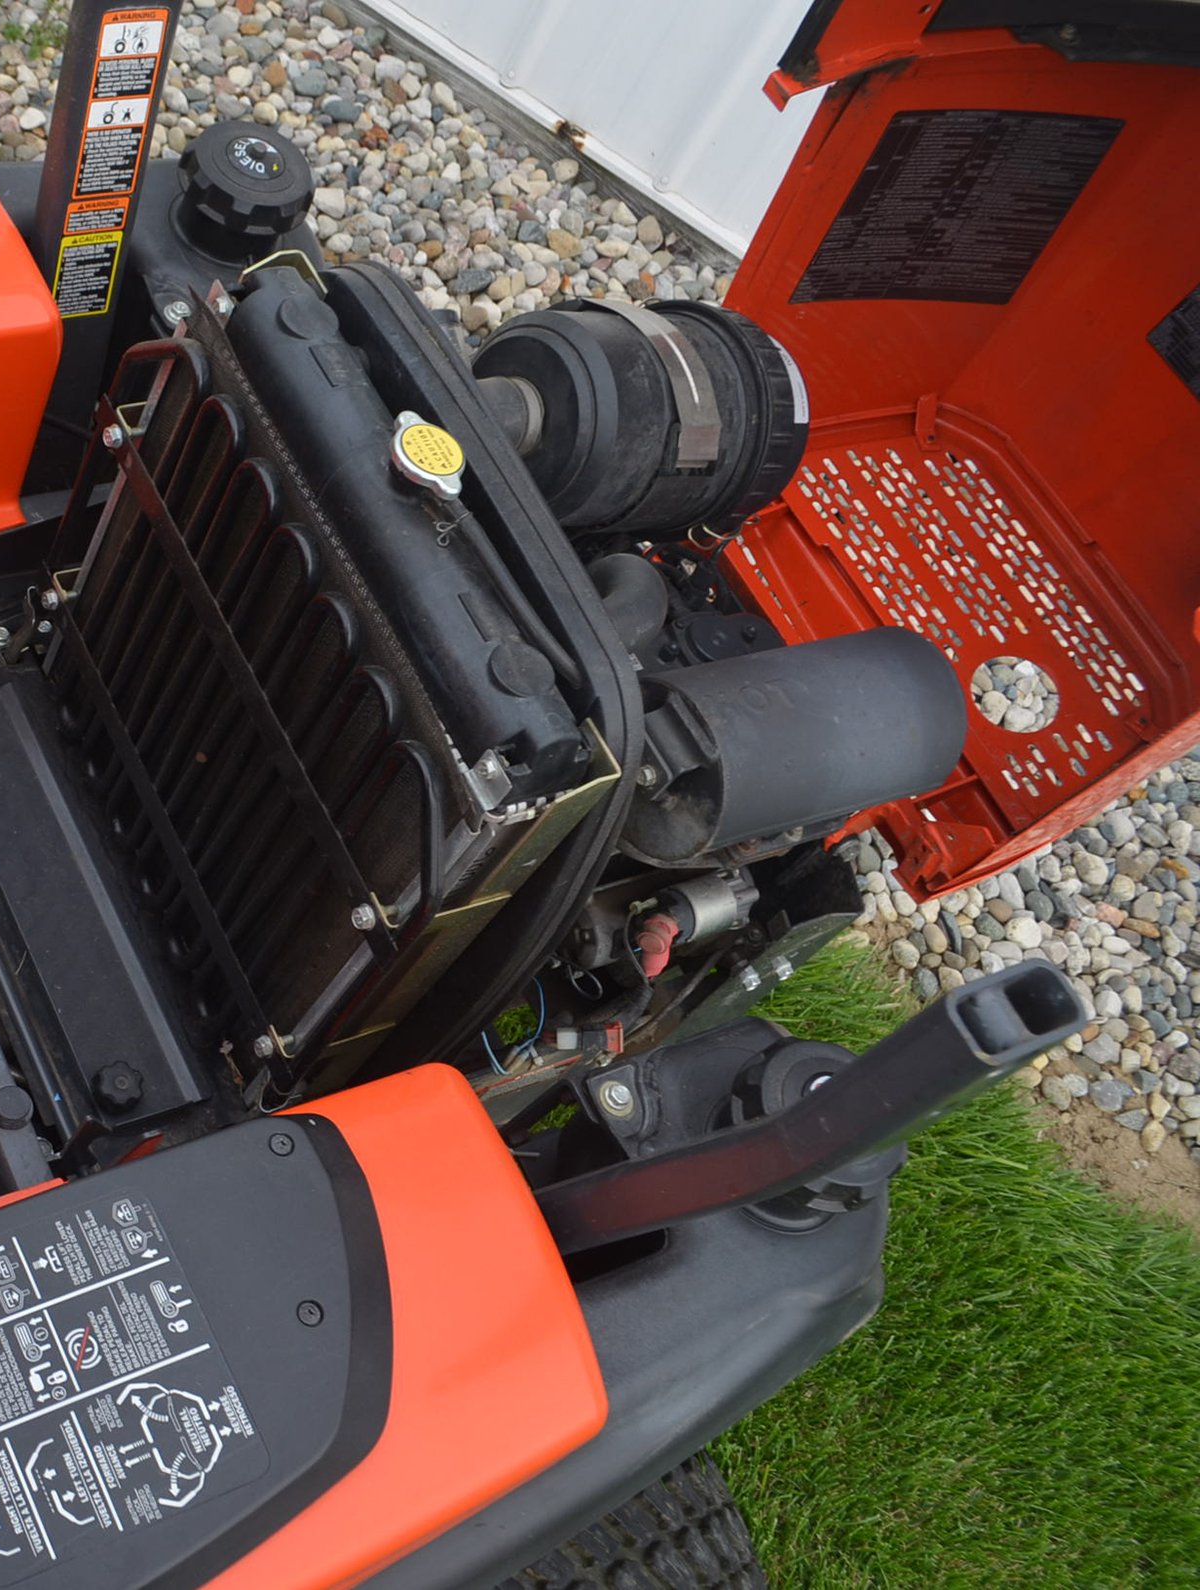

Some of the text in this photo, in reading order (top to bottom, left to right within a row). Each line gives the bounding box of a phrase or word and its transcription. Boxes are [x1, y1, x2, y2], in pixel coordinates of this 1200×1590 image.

[234, 140, 265, 174] DIESEL
[78, 234, 114, 242] CAUTION
[54, 1219, 87, 1283] PEDAL LH TO LOWER
[56, 1241, 80, 1286] DEPRESS LIFT
[72, 1242, 87, 1267] MOWER
[83, 1266, 93, 1280] THE
[86, 1309, 119, 1377] DEPRESS PARKING
[96, 1313, 127, 1374] BRAKE PEDAL TO
[100, 1304, 134, 1371] RELEASE PARKING
[85, 1403, 102, 1433] NEUTRAL
[104, 1392, 119, 1418] NEUTRO
[218, 1393, 242, 1434] REVERSE
[225, 1383, 254, 1436] RETROCESO
[177, 1407, 203, 1454] NEUTRAL
[188, 1405, 211, 1447] NEUTRO
[61, 1418, 112, 1527] VUELTA A LA IZQUIERDA
[62, 1451, 89, 1503] LEFT TURN
[92, 1443, 117, 1489] FORWARD
[105, 1443, 126, 1480] AVANCE
[14, 1493, 26, 1507] LA
[20, 1506, 29, 1515] A
[123, 1494, 140, 1525] NEUTRAL
[142, 1482, 158, 1510] NEUTRO
[5, 1504, 23, 1534] RIGHT
[23, 1515, 44, 1552] VUELTA
